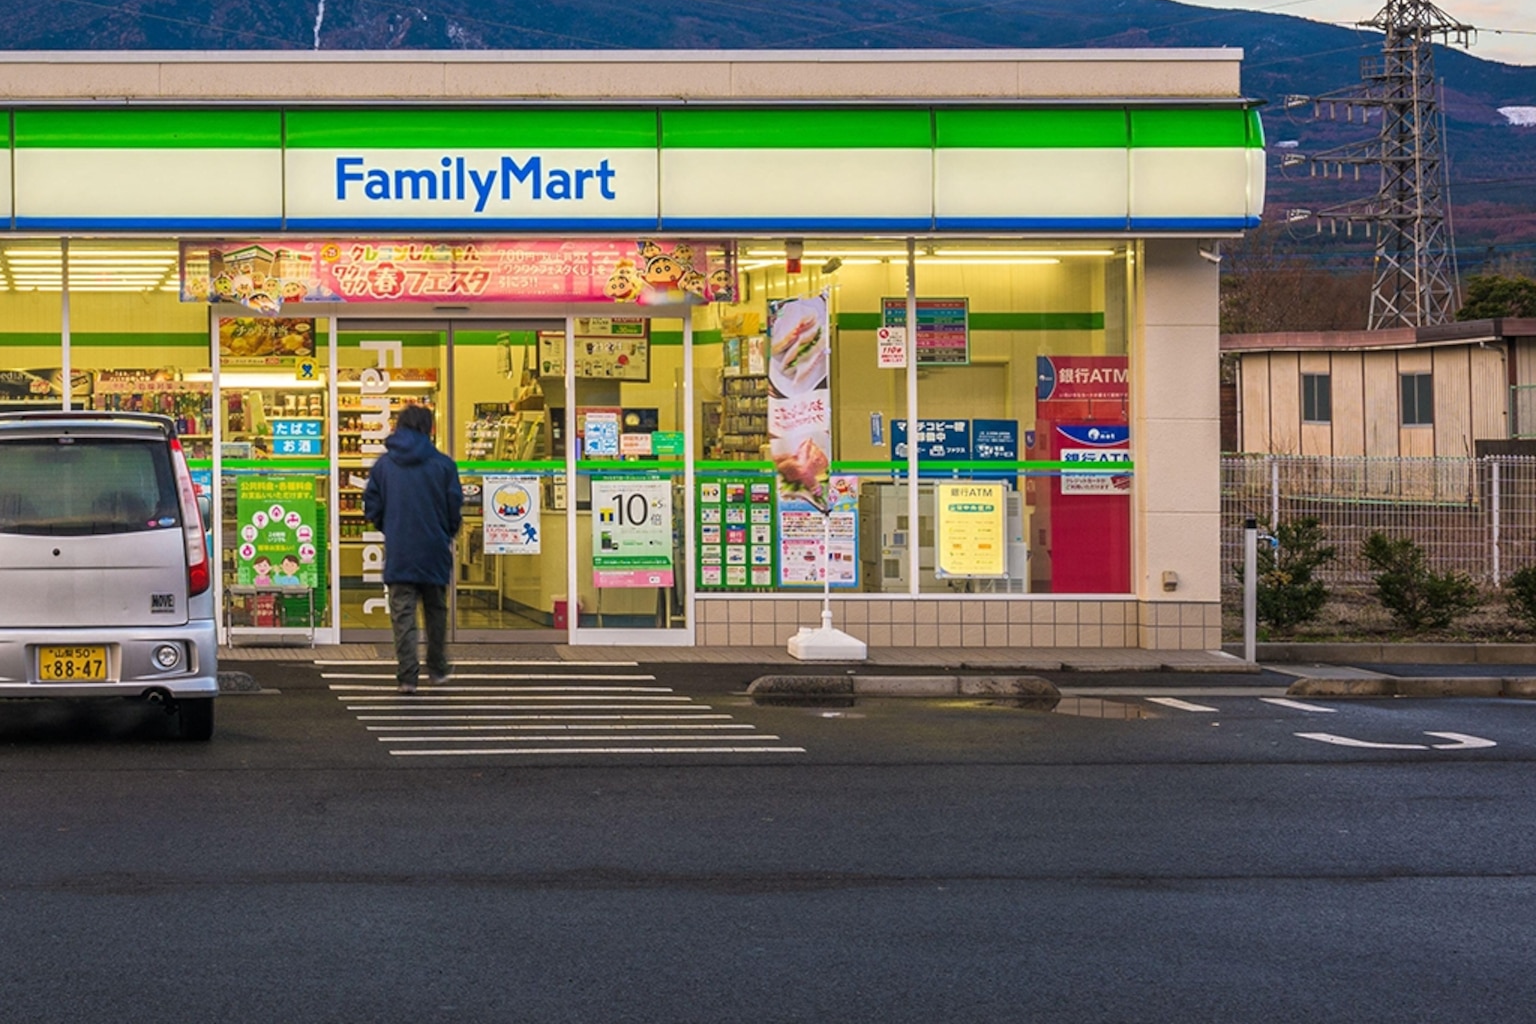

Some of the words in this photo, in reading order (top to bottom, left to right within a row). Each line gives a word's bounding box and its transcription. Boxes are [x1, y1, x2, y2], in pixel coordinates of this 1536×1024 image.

[336, 156, 616, 213] FamilyMart
[276, 422, 318, 436] たばこ
[282, 439, 312, 454] お酒
